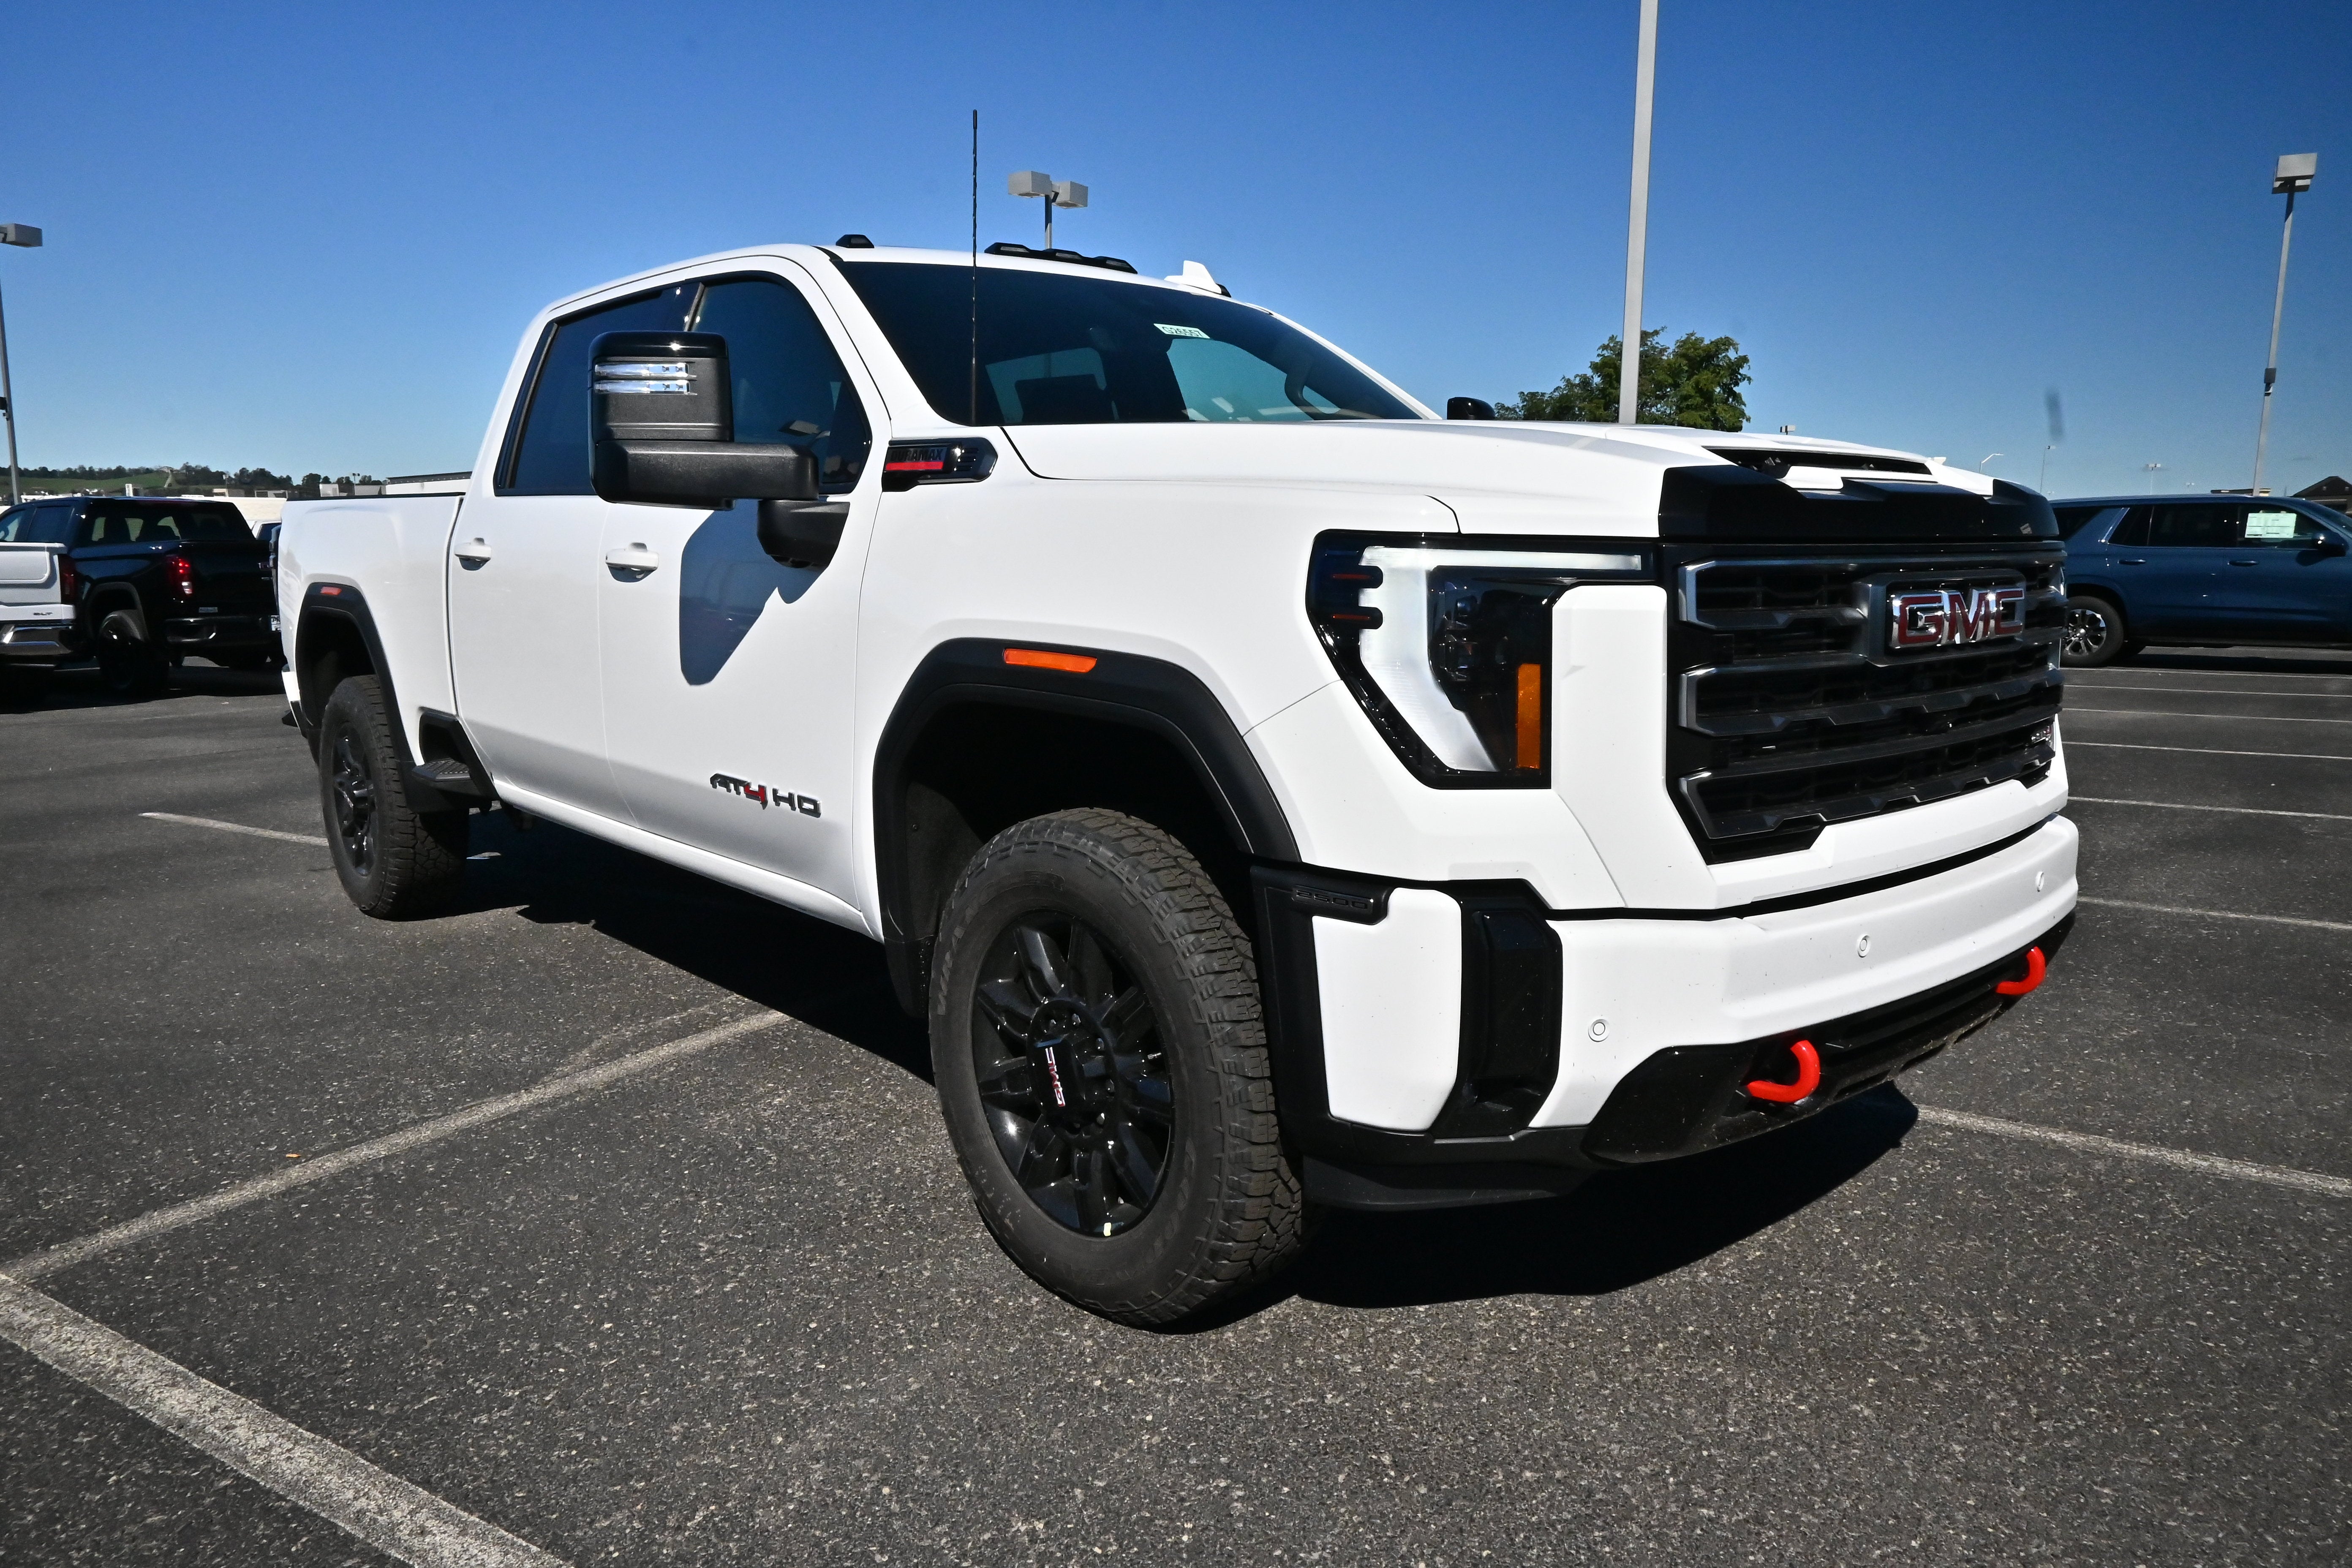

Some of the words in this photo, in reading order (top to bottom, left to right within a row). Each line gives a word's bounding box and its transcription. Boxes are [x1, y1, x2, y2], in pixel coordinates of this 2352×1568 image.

[890, 449, 943, 461] DURAMAX
[1890, 588, 2025, 648] GMC
[772, 788, 822, 818] HD
[1296, 890, 1368, 909] 2500
[1045, 1047, 1066, 1108] GMC
